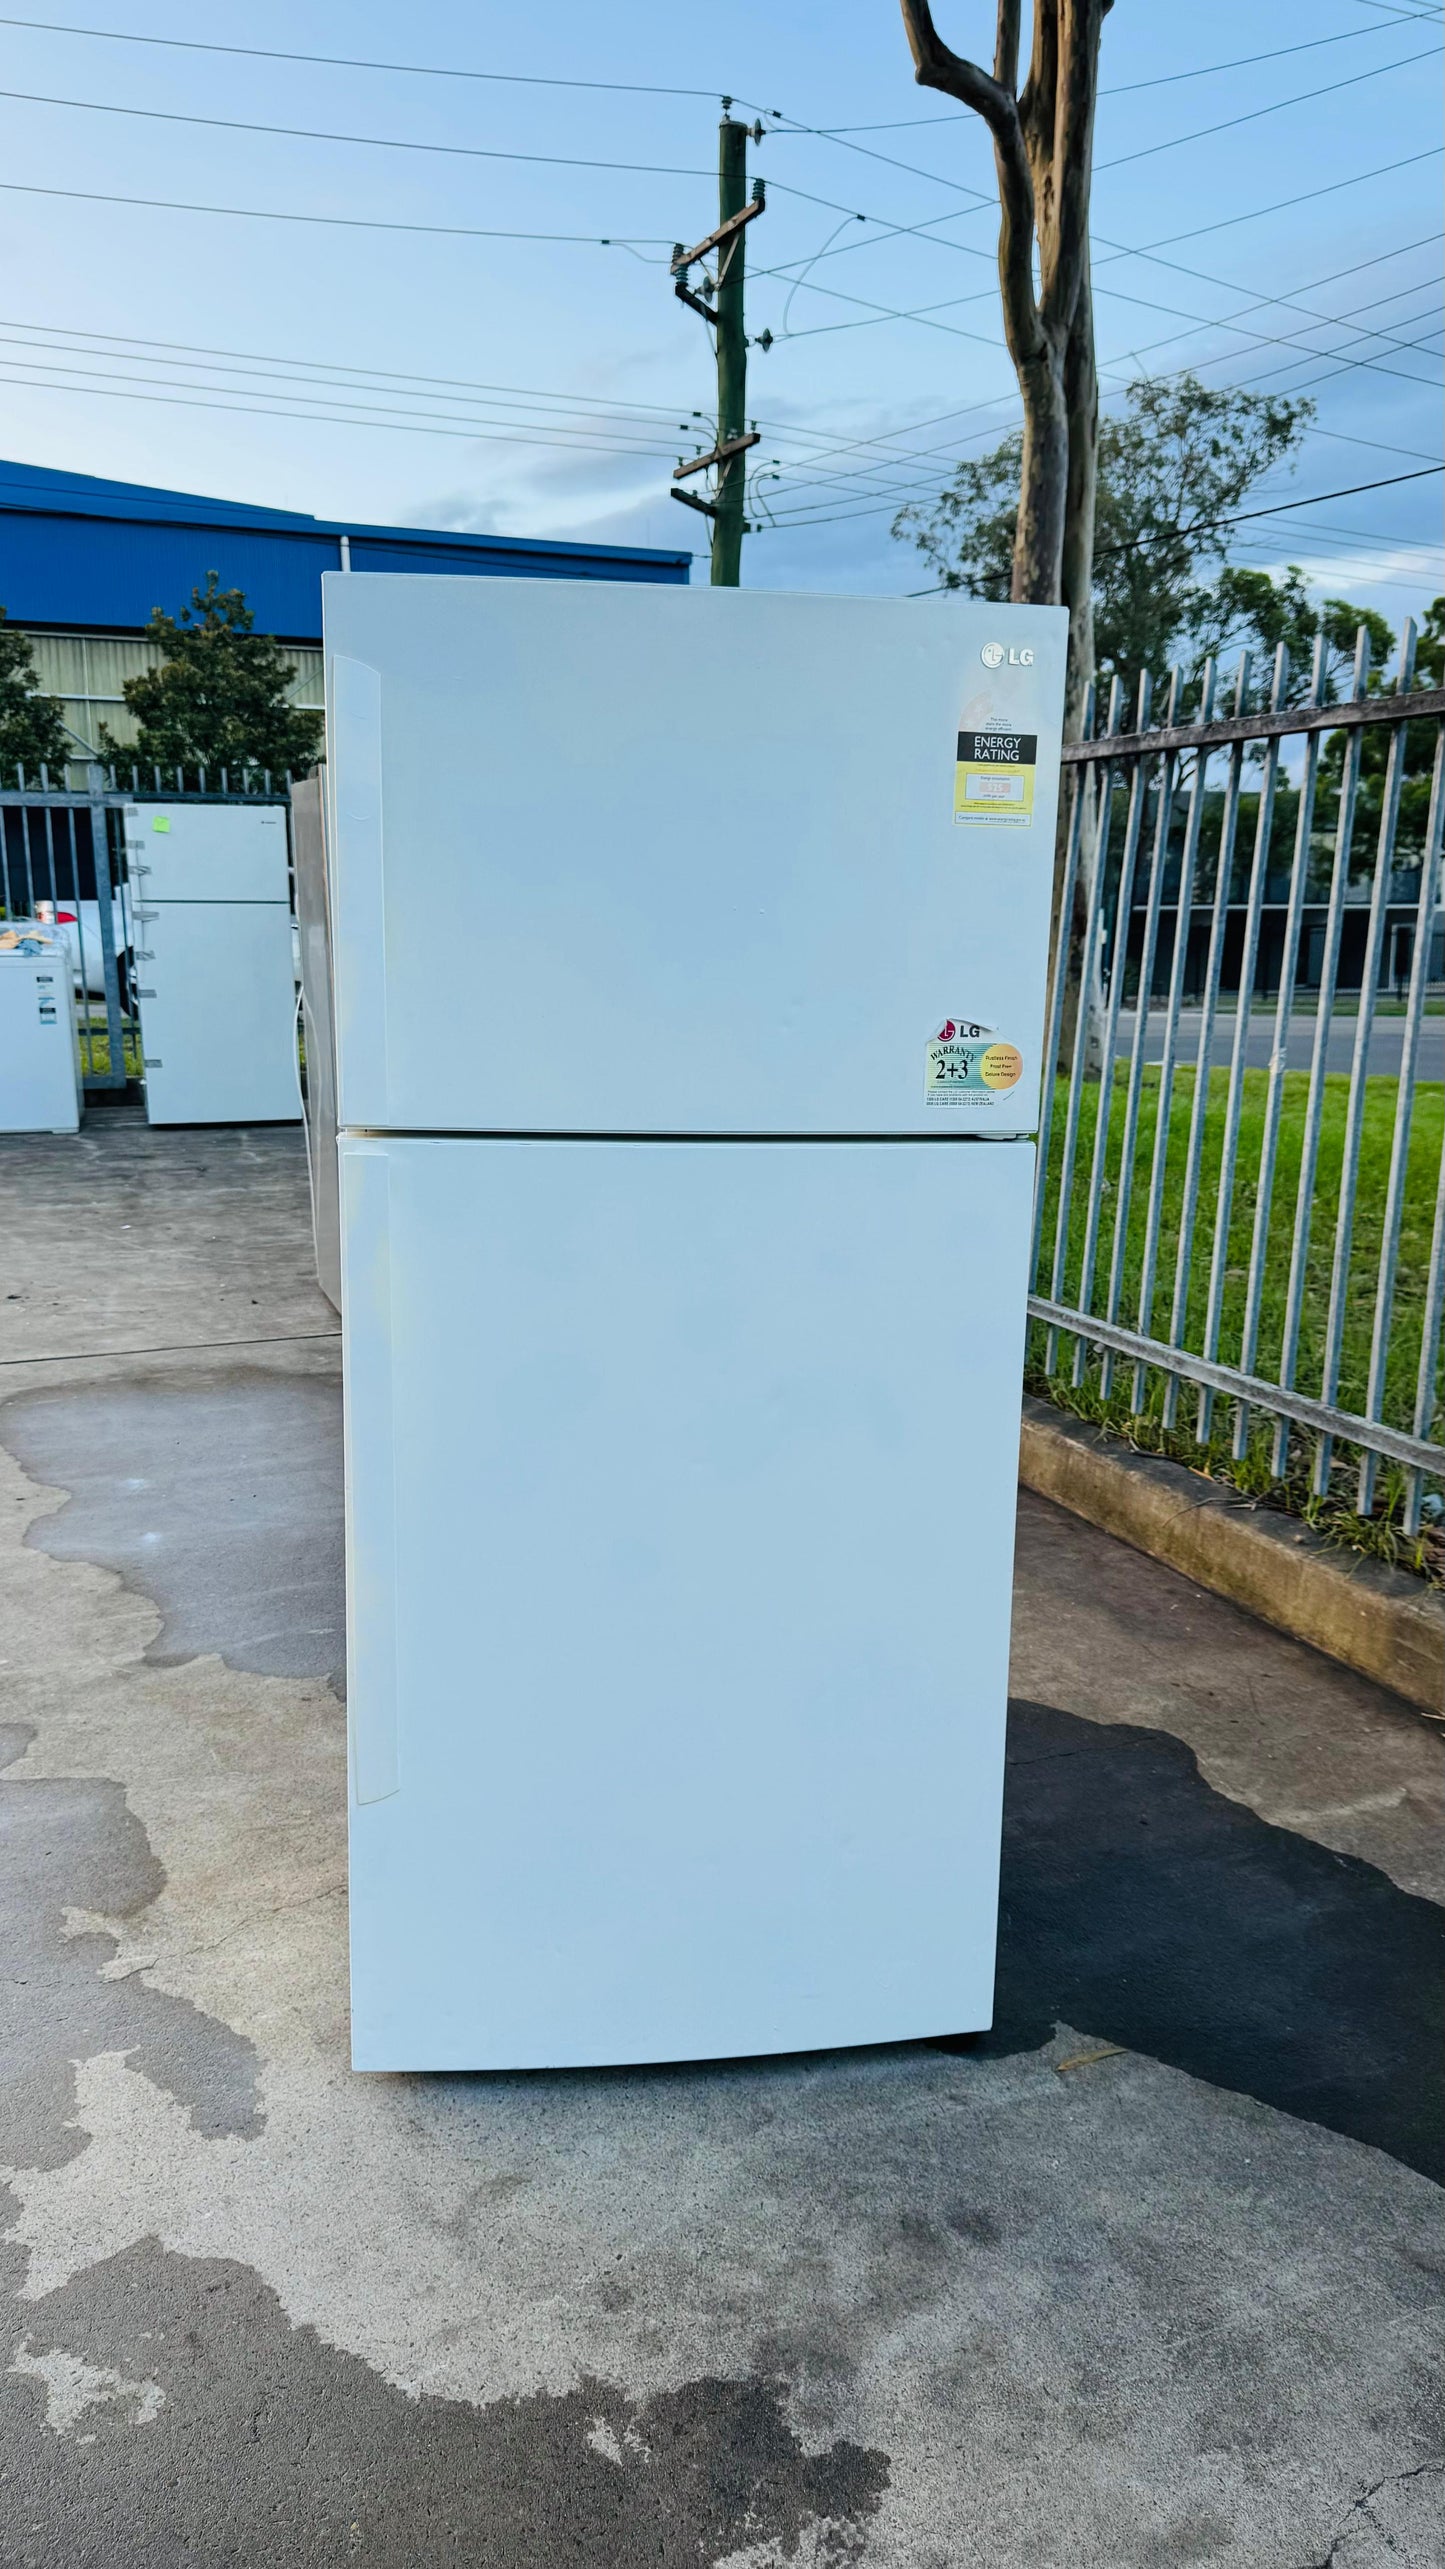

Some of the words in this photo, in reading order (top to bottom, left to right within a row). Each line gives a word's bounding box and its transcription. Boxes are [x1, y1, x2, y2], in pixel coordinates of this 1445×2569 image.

[1008, 648, 1034, 666] LG
[974, 736, 1021, 749] ENERGY
[974, 748, 1020, 761] RATING
[960, 1025, 980, 1038] LG
[930, 1045, 976, 1062] WARRANTY
[935, 1059, 969, 1080] 2+3
